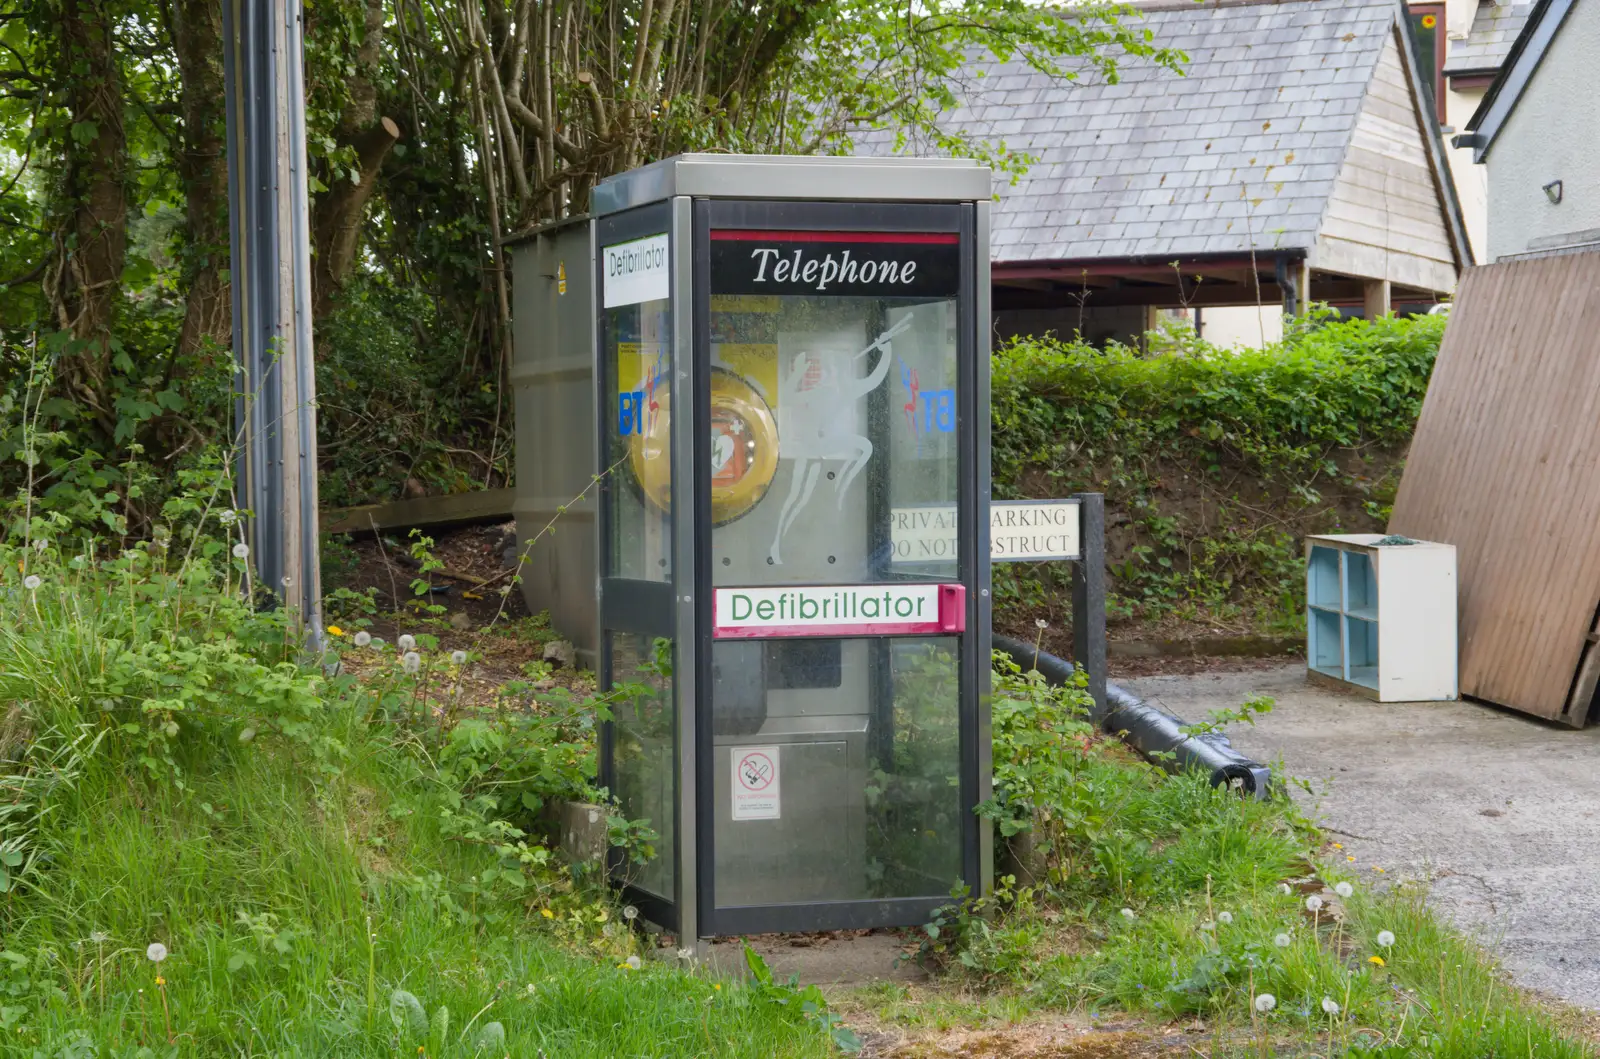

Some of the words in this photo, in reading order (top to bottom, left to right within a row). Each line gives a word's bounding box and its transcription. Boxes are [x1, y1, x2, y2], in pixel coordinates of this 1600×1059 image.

[610, 244, 665, 277] Defibrillator
[751, 249, 917, 290] Telephone
[619, 391, 643, 435] BT
[890, 511, 957, 529] RIVAT
[991, 508, 1066, 527] ARKING
[918, 538, 957, 556] NOT
[990, 534, 1070, 553] STRUCT
[732, 591, 925, 621] Defibrillator
